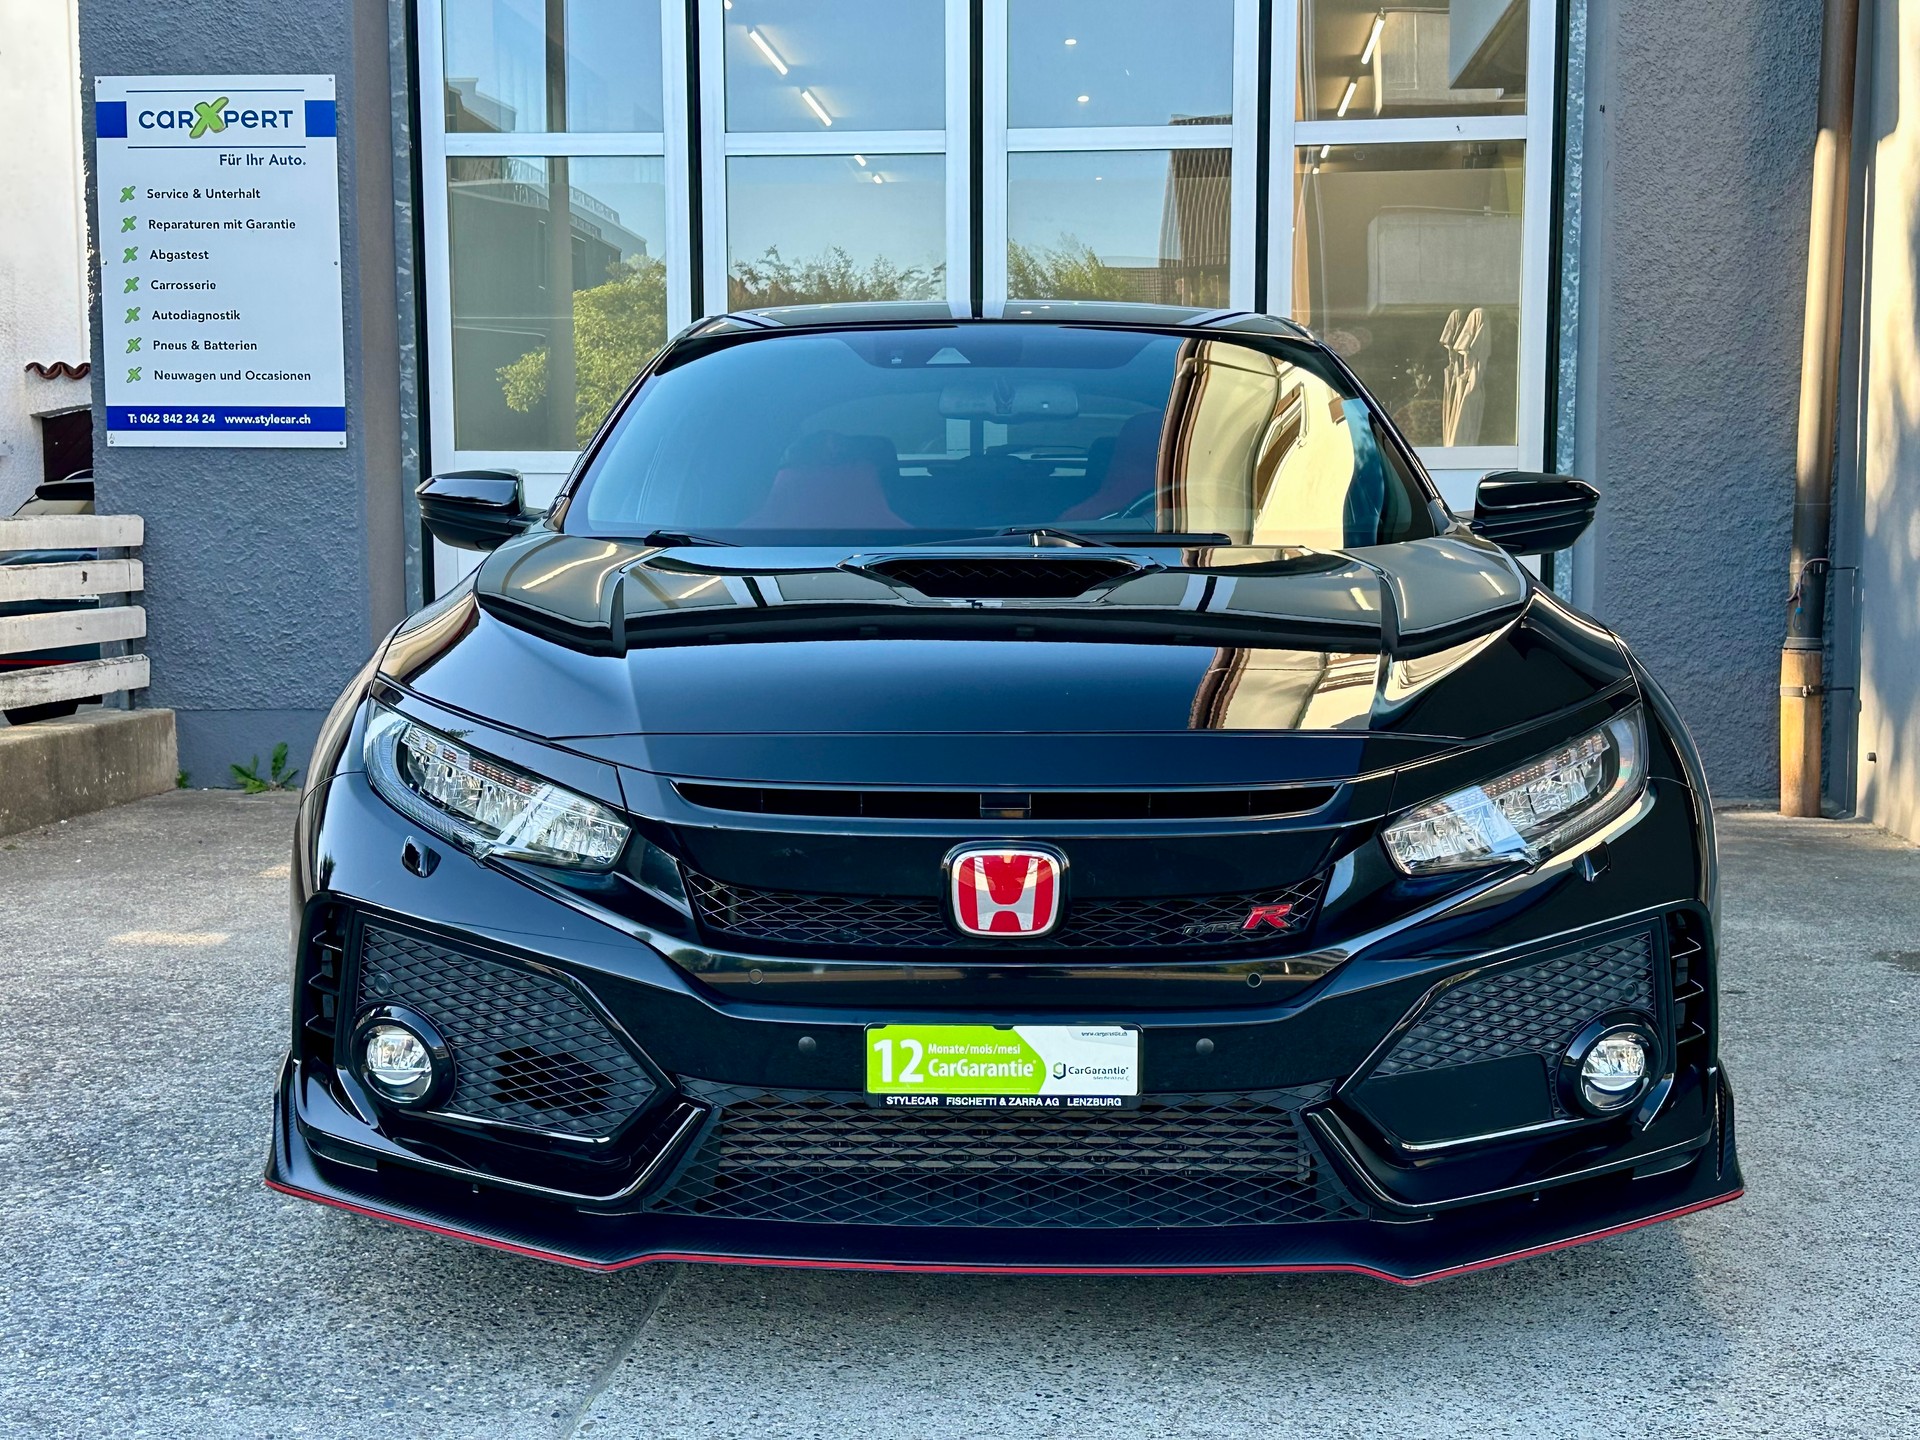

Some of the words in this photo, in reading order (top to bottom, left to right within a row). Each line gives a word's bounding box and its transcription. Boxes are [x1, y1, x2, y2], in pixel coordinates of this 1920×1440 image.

[219, 153, 242, 166] Für
[246, 153, 265, 166] Ihr
[268, 153, 306, 166] Auto.
[147, 188, 189, 199] Service
[192, 188, 202, 199] &
[205, 188, 261, 199] Unterhalt
[148, 219, 220, 232] Reparaturen
[223, 219, 243, 230] mit
[246, 218, 296, 230] Garantie
[149, 249, 209, 263] Abgastest
[150, 279, 217, 290] Carrosserie
[151, 309, 241, 323] Autodiagnostik
[153, 340, 187, 351] Pneus
[190, 340, 200, 351] &
[203, 340, 258, 351] Batterien
[154, 370, 216, 383] Neuwagen
[219, 369, 241, 381] und
[245, 370, 312, 381] Occasionen
[128, 413, 137, 424] T:
[140, 413, 160, 424] 062
[162, 413, 183, 424] 842
[185, 413, 199, 424] 24
[201, 413, 216, 424] 24
[224, 413, 311, 427] www.stylecar.ch
[1241, 902, 1294, 930] R
[927, 1043, 1021, 1055] Monate/mois/mesi
[873, 1038, 924, 1083] 12
[886, 1096, 939, 1106] STYLECAR
[946, 1097, 997, 1106] FISCHETTI
[999, 1097, 1007, 1106] &
[1008, 1097, 1043, 1106] ZARRA
[1044, 1097, 1060, 1107] AG
[1067, 1097, 1122, 1107] LENZBURG
